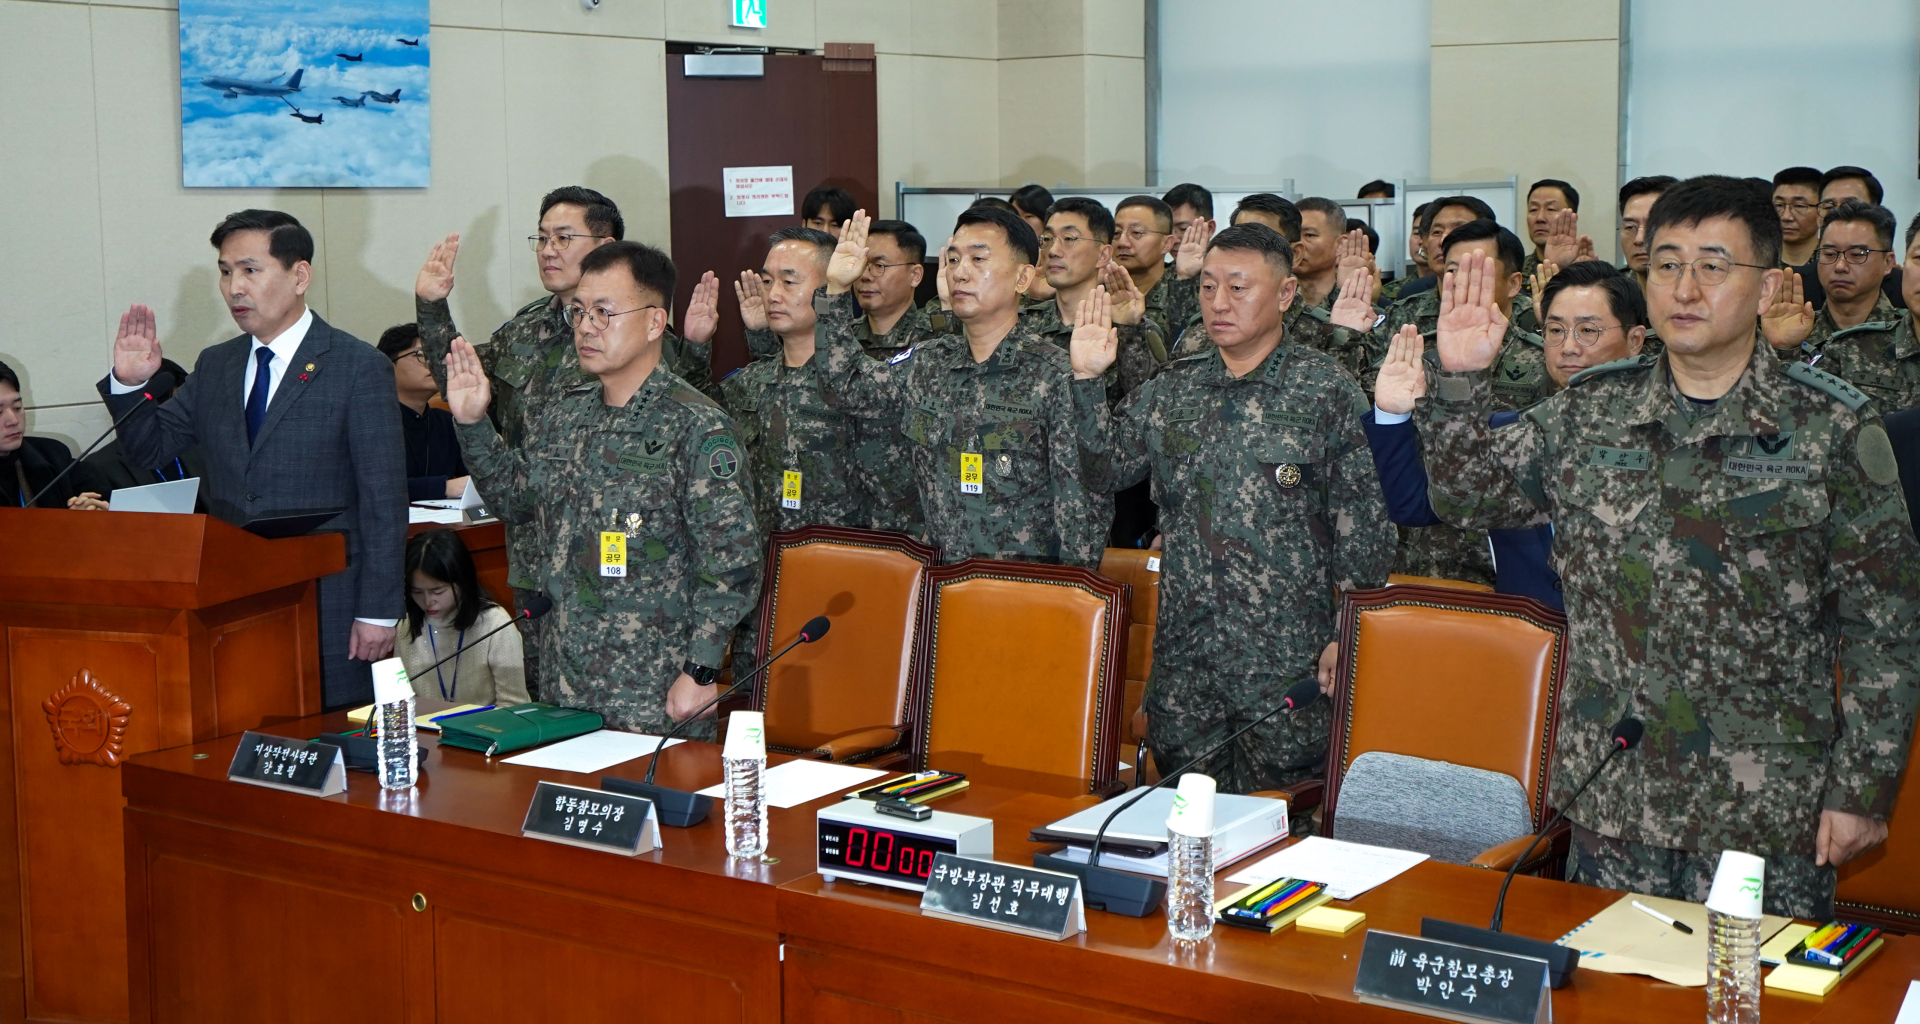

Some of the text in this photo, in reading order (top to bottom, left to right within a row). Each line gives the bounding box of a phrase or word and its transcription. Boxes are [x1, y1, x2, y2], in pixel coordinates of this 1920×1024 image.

[1729, 462, 1806, 474] 대한민국 육군 ROKA
[964, 472, 978, 481] 공무
[966, 484, 978, 492] 119
[786, 500, 797, 508] 113
[606, 553, 621, 564] 공무
[606, 566, 621, 575] 108
[254, 743, 318, 766] 지상작전사령관
[555, 796, 624, 822] 합동참모의장
[846, 828, 894, 872] 00
[934, 864, 1070, 906] 국방부장관 직무대행
[1390, 948, 1514, 988] 前 육군참모총장
